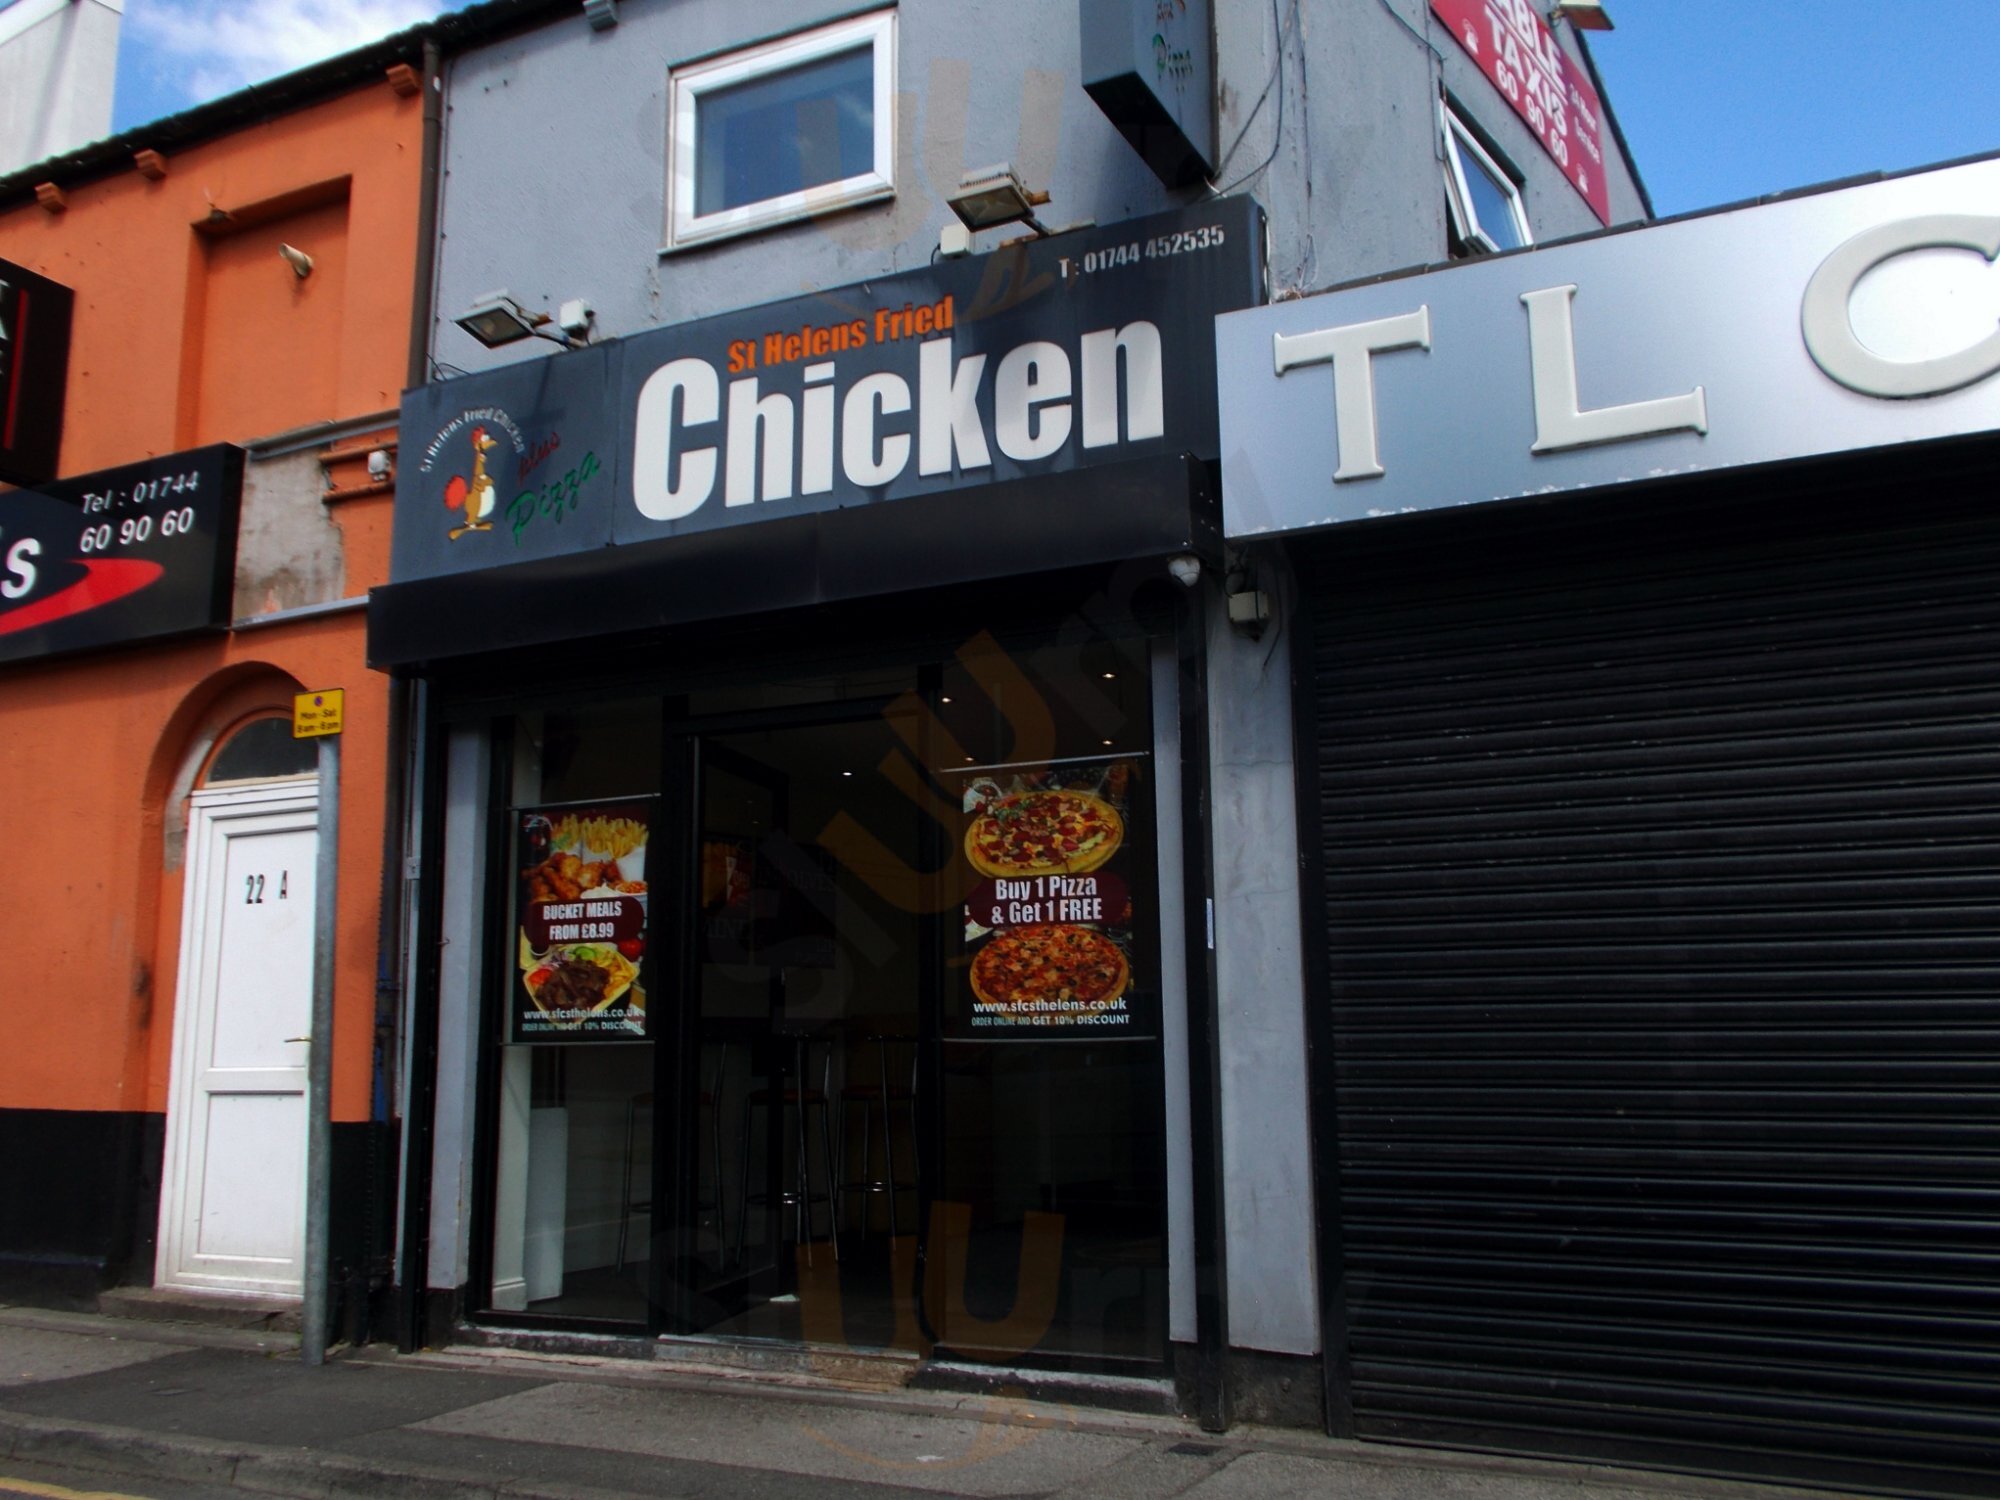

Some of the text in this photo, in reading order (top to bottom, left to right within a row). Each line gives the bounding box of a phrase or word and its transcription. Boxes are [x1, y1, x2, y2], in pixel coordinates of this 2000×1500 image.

[1484, 3, 1568, 136] TAXIS
[1495, 58, 1569, 167] 60 90 60
[1084, 242, 1141, 273] 01744
[1145, 224, 1225, 259] 452535
[727, 294, 954, 373] St Helens Fried
[632, 320, 1165, 522] Chicken
[82, 489, 112, 514] Tel
[133, 470, 199, 503] 01744
[505, 451, 601, 547] Pizza
[80, 506, 194, 553] 60 90 60
[246, 870, 288, 904] 22 A
[996, 876, 1097, 901] Buy 1 Pizza
[543, 901, 622, 920] BUCKET MEALS
[549, 922, 615, 941] FROM £8.99
[991, 898, 1102, 924] & Get 1 FREE
[973, 997, 1127, 1013] www.sfcsthelens.co.uk
[1032, 1015, 1051, 1025] GET
[1054, 1014, 1074, 1025] 10%
[1077, 1013, 1130, 1025] DISCOUNT
